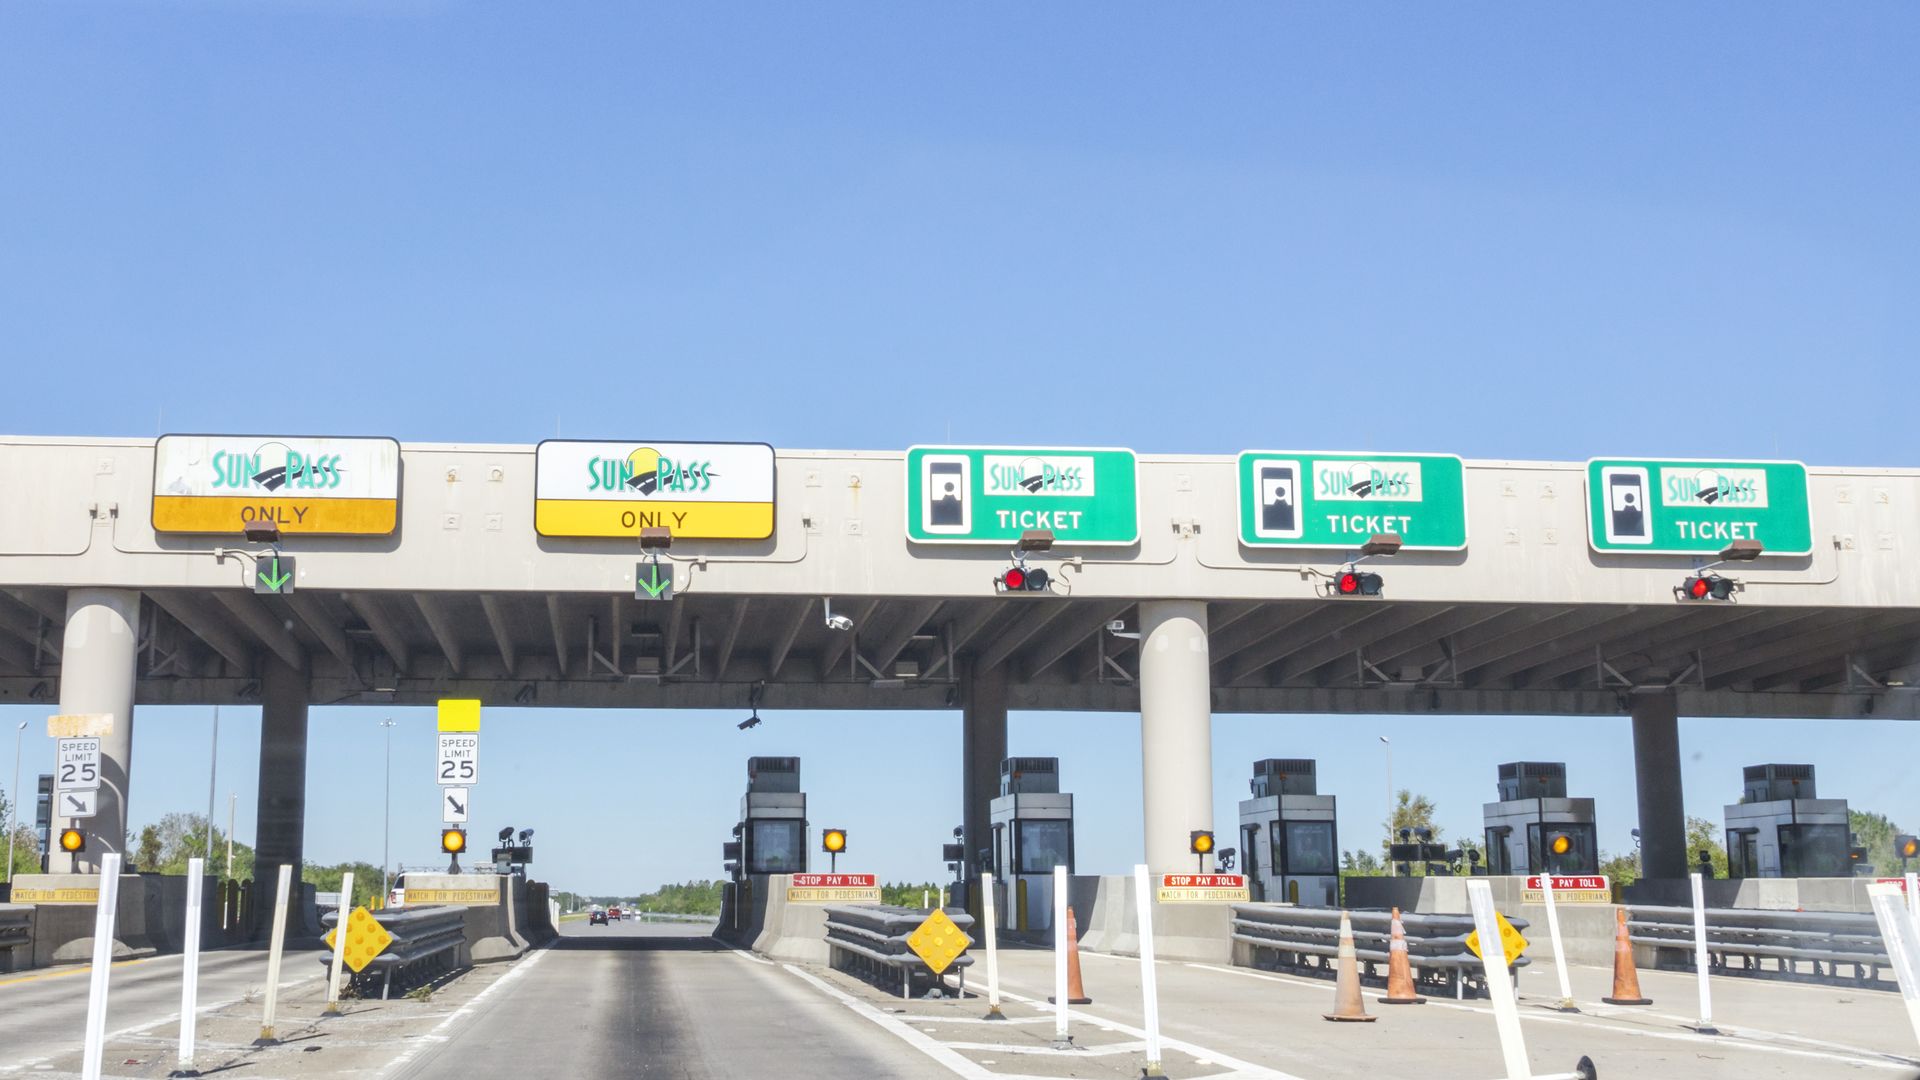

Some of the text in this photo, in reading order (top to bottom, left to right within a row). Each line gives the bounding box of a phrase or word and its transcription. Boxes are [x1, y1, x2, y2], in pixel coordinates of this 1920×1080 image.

[240, 506, 309, 524] ONLY
[622, 511, 688, 529] ONLY
[996, 510, 1083, 530] TICKET
[1326, 515, 1412, 534] TICKET
[1675, 521, 1758, 540] TICKET
[62, 743, 97, 752] SPEED
[442, 739, 476, 748] SPEED
[65, 753, 92, 762] LIMIT
[444, 750, 472, 758] LIMIT
[61, 763, 96, 783] 25
[441, 760, 474, 778] 25
[801, 876, 868, 885] STOP PAY TOLL
[1172, 877, 1236, 886] STOP PAY TOLL
[1559, 880, 1574, 888] PAY
[1580, 880, 1597, 888] TOLL
[15, 890, 36, 900] WATCH
[408, 891, 428, 900] WATCH
[434, 891, 448, 900] FOR
[792, 890, 878, 899] WATCH FOR PEDESTRIANS
[1162, 890, 1246, 899] WATCH FOR PEDESTRIANS
